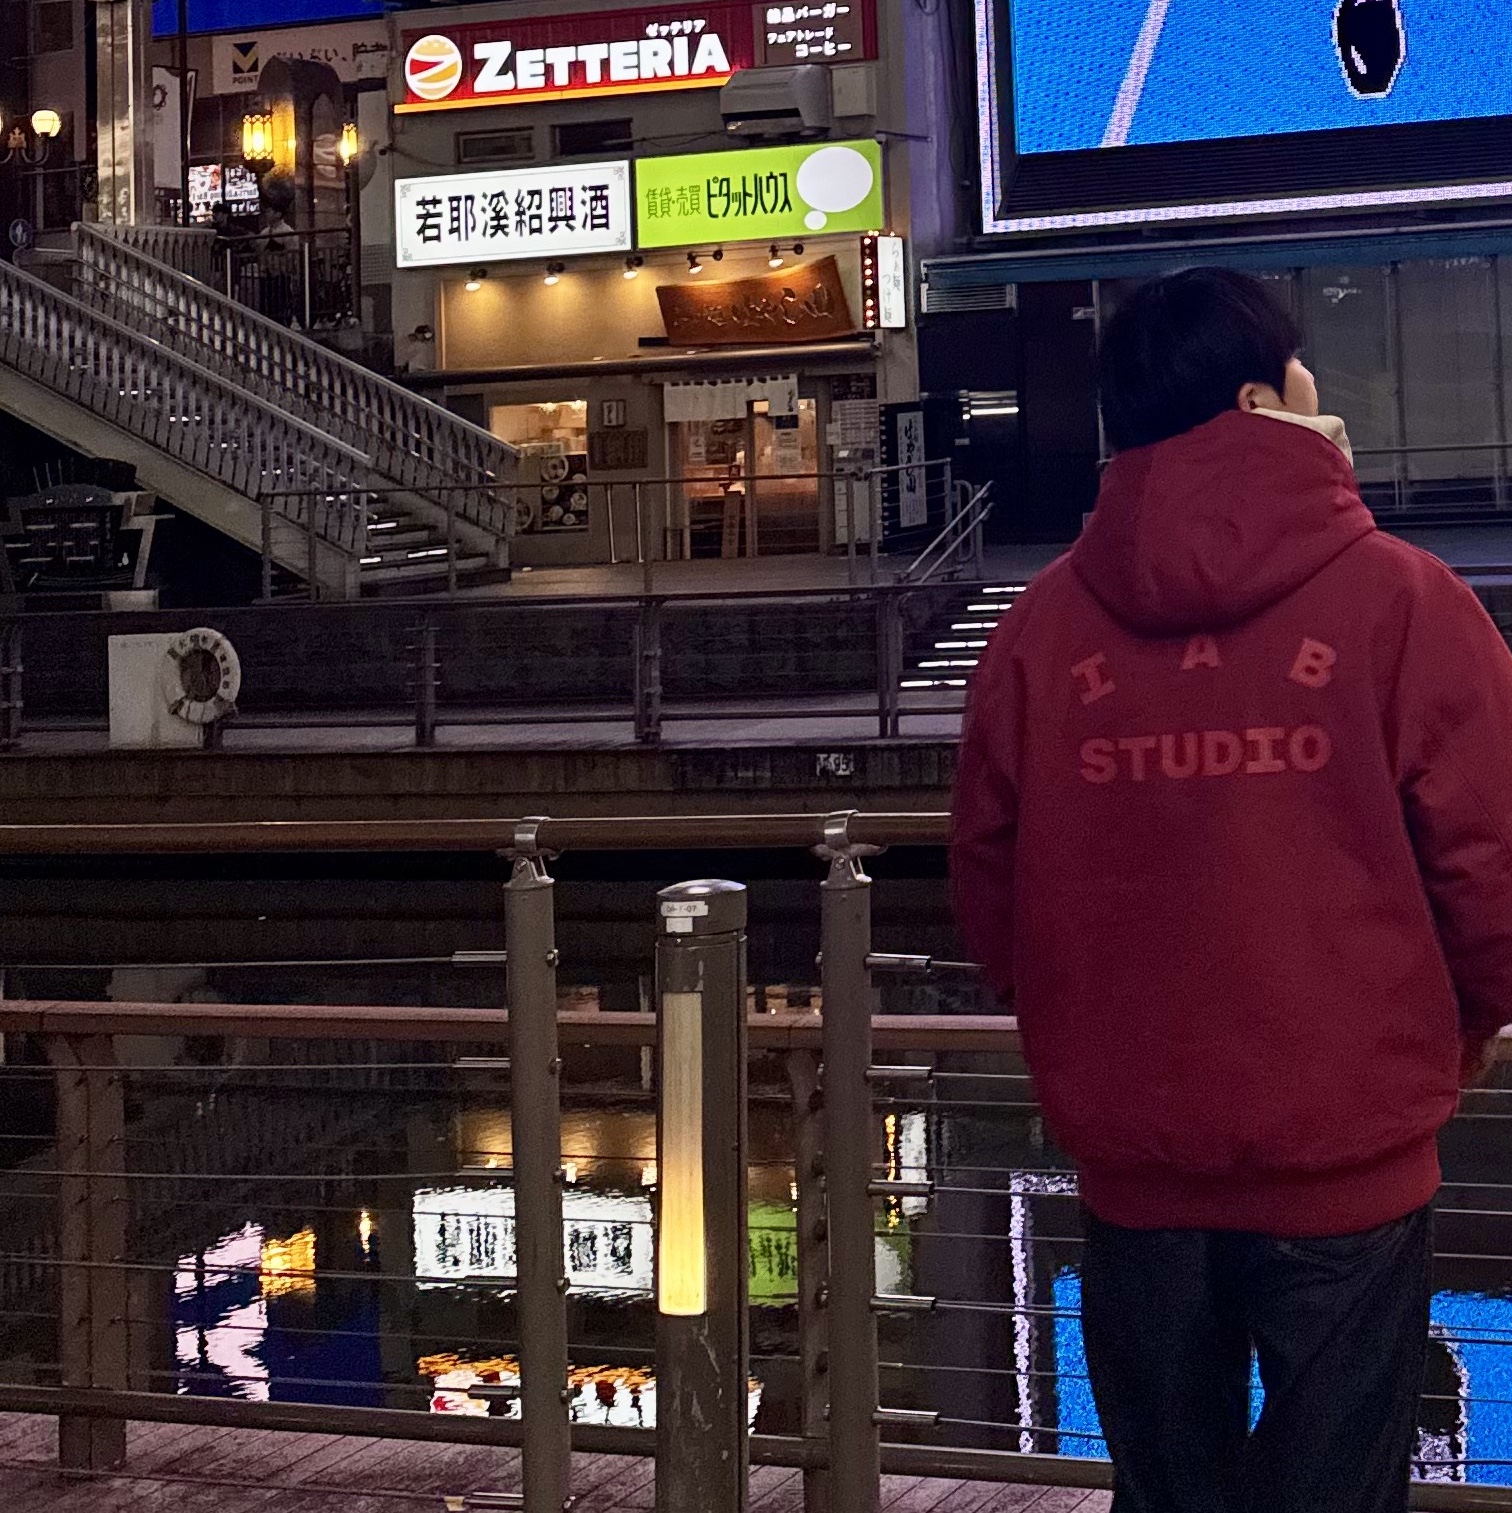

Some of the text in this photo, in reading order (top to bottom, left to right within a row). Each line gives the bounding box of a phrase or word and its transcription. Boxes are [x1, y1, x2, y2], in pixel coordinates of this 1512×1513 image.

[473, 33, 730, 93] ZETTERIA
[795, 40, 852, 58] コーヒー
[706, 171, 793, 219] ピタットハウス
[1079, 724, 1331, 784] STUDIO
